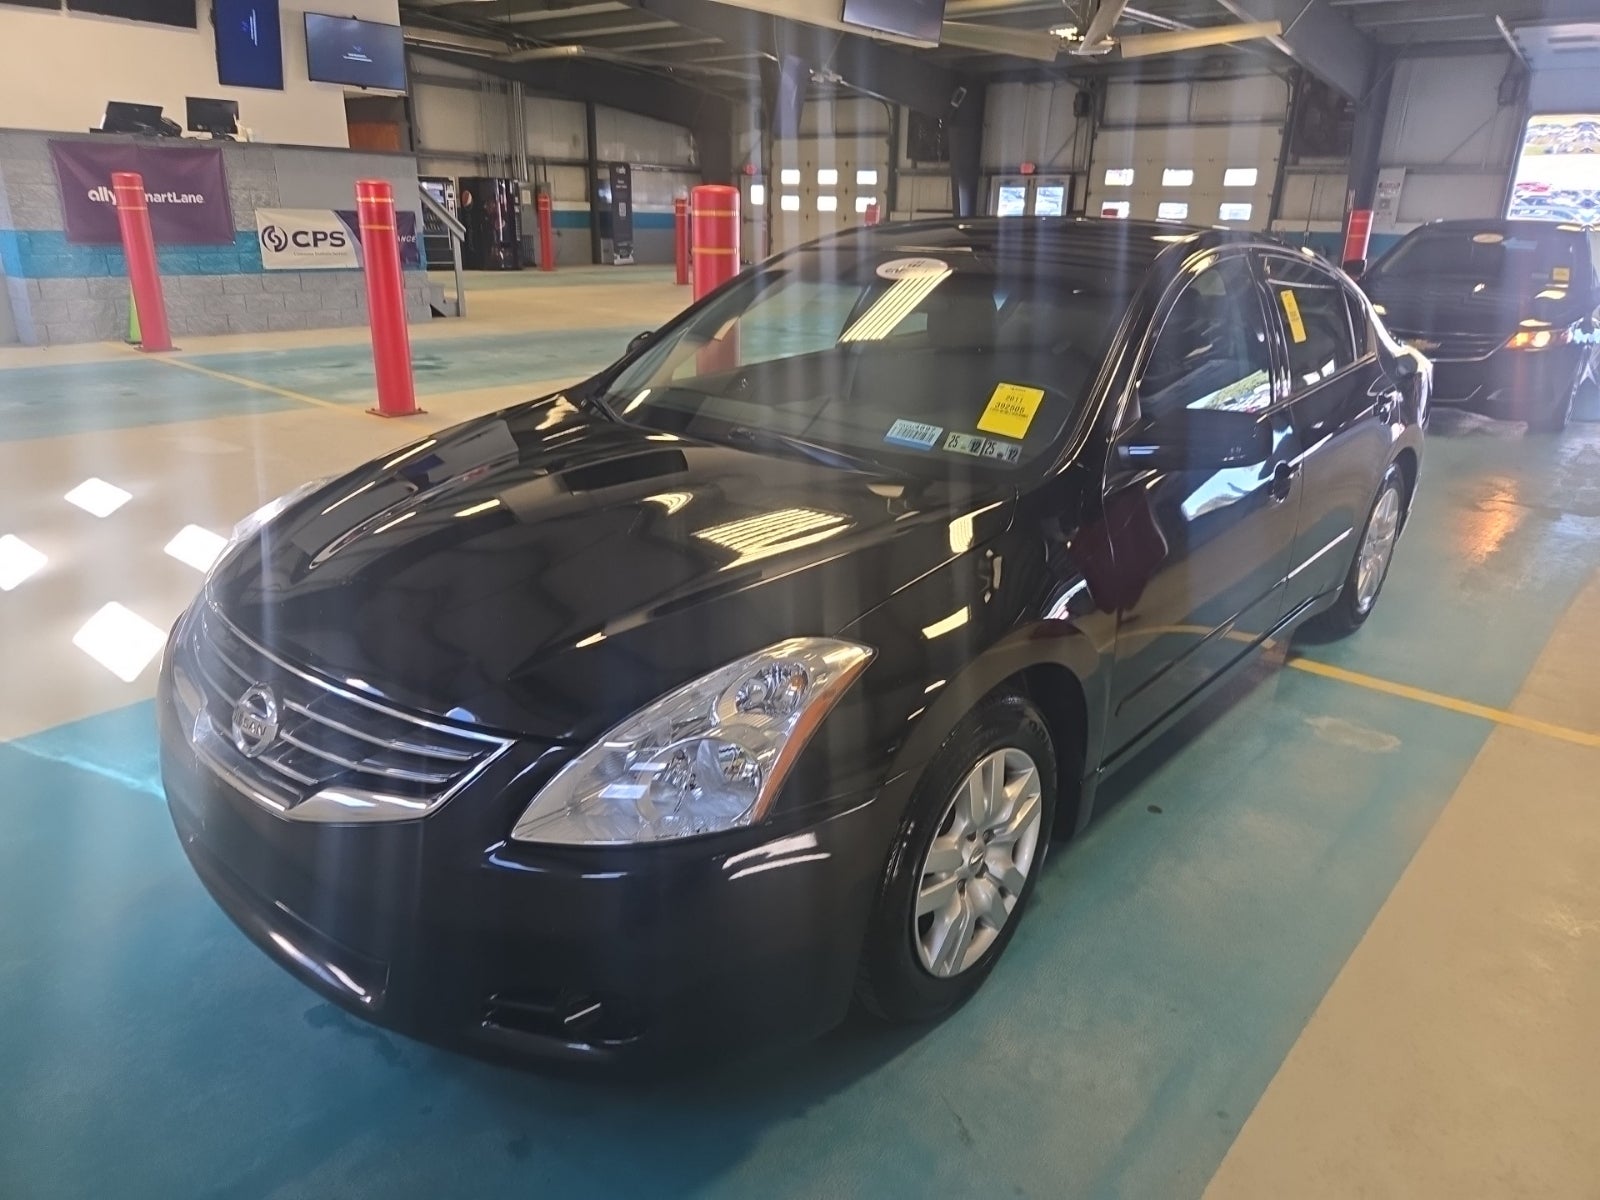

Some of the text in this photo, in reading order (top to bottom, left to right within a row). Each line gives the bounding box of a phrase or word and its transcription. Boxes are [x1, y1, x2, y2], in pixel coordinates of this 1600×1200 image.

[87, 186, 205, 206] ally martLane
[291, 230, 346, 248] CPS
[948, 434, 960, 449] 25
[984, 441, 997, 456] 25
